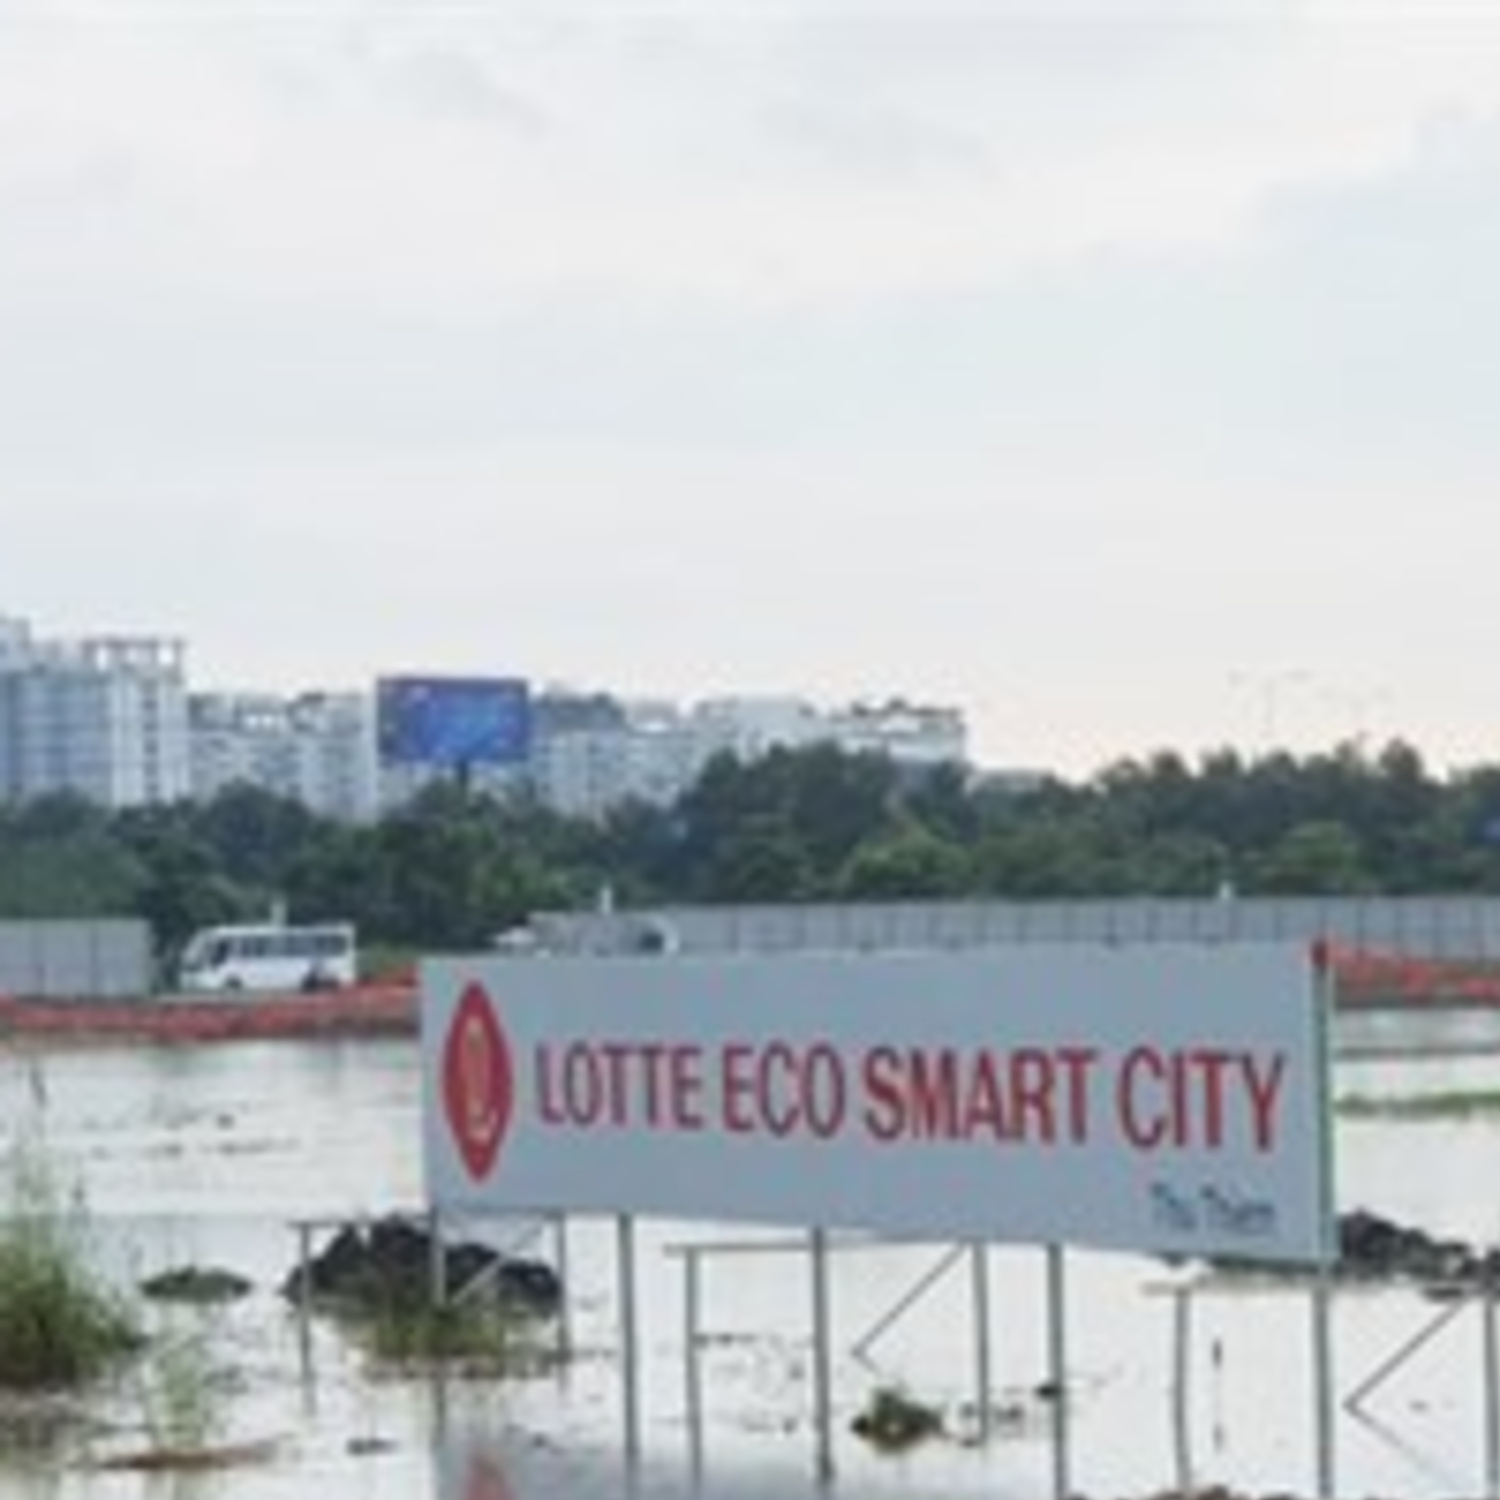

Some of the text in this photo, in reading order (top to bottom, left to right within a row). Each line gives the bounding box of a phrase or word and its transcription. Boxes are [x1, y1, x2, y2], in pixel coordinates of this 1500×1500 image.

[535, 1041, 1284, 1151] LOTTE ECO SMART CITY
